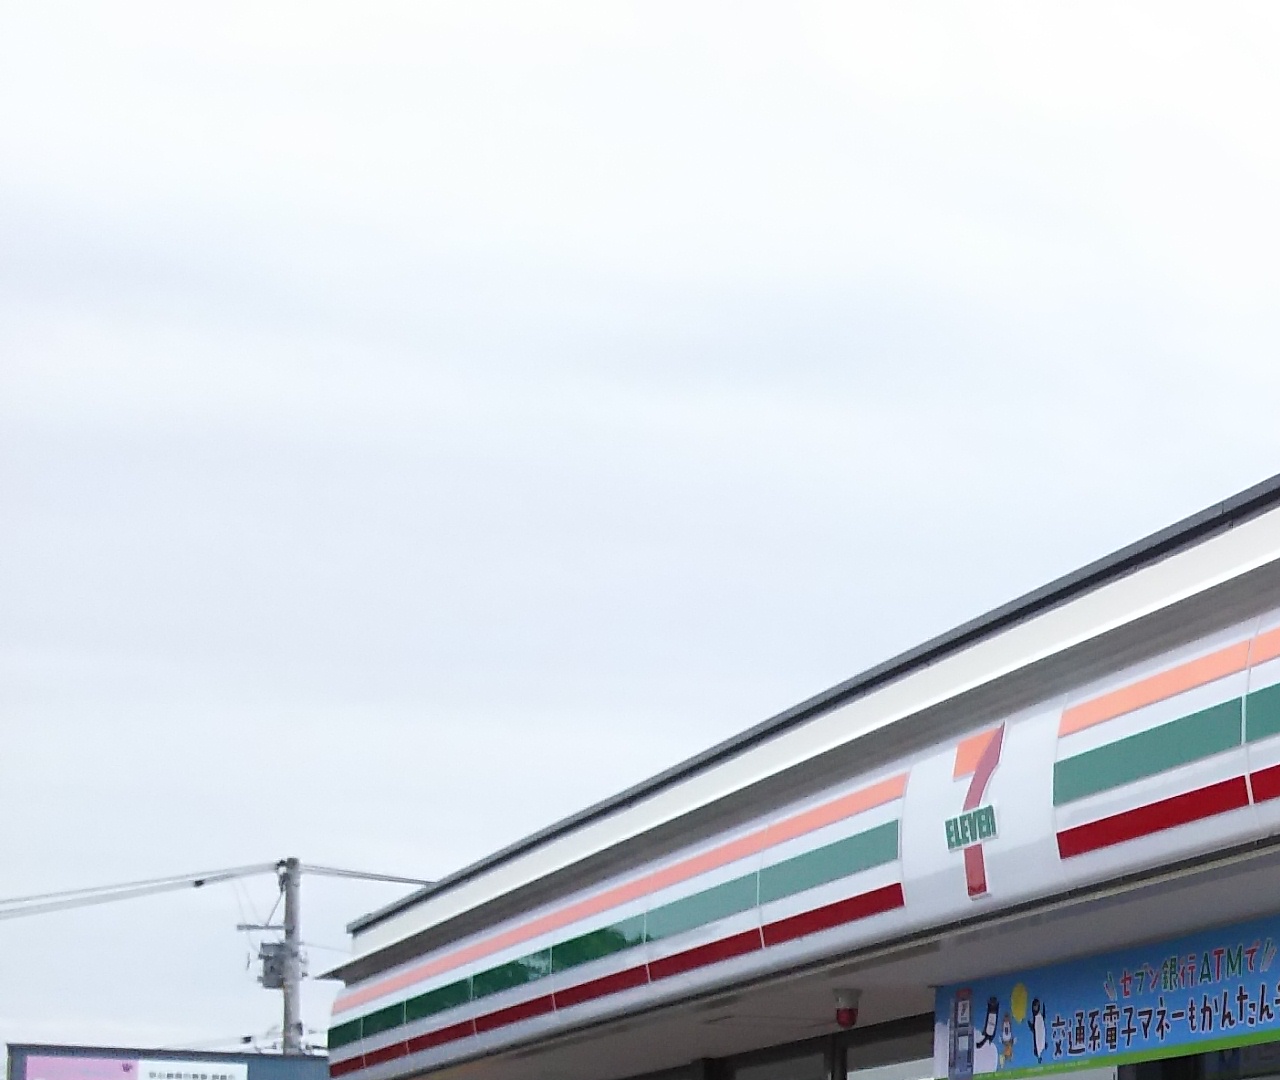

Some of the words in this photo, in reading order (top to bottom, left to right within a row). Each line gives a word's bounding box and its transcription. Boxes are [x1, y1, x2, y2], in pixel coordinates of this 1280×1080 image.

[1119, 938, 1262, 997] セブン銀行ATMで
